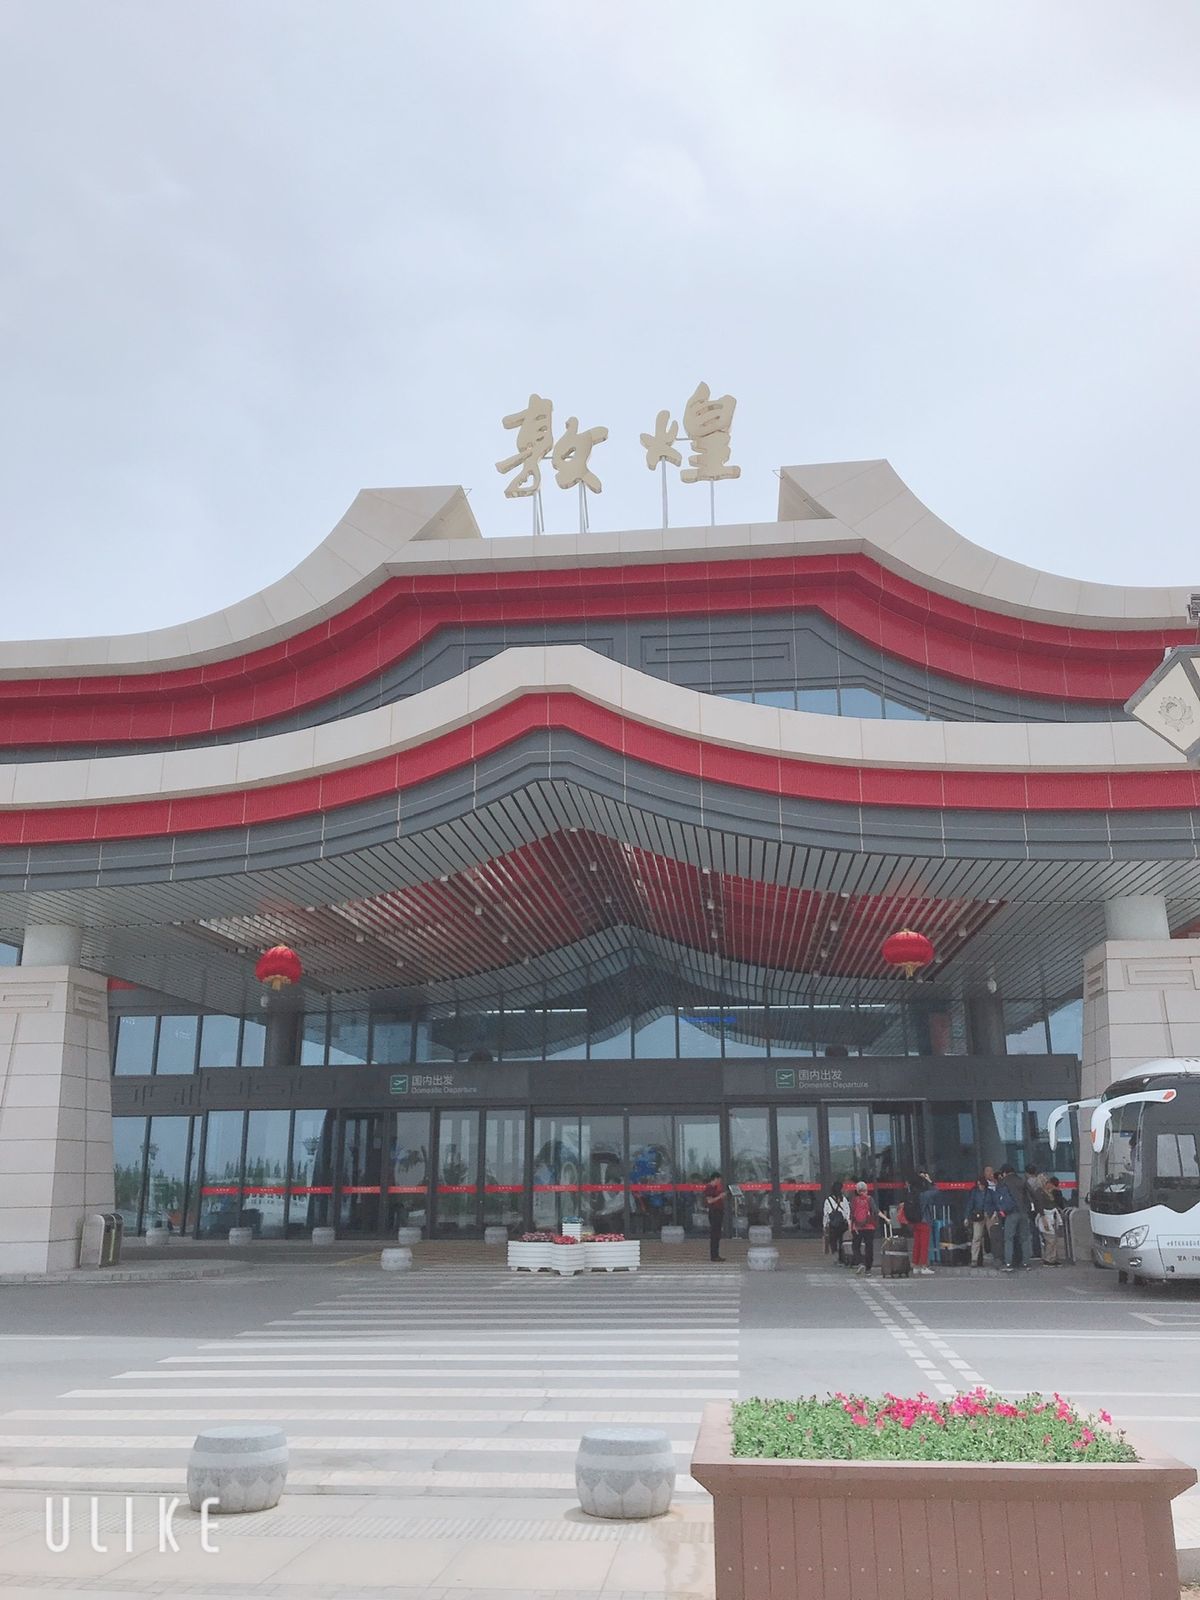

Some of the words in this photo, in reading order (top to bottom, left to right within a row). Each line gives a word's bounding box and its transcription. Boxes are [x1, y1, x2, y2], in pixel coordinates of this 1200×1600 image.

[495, 381, 741, 498] 敦煌
[411, 1075, 453, 1086] 国内出发
[799, 1070, 842, 1081] 国内出发
[444, 1087, 477, 1095] Departure
